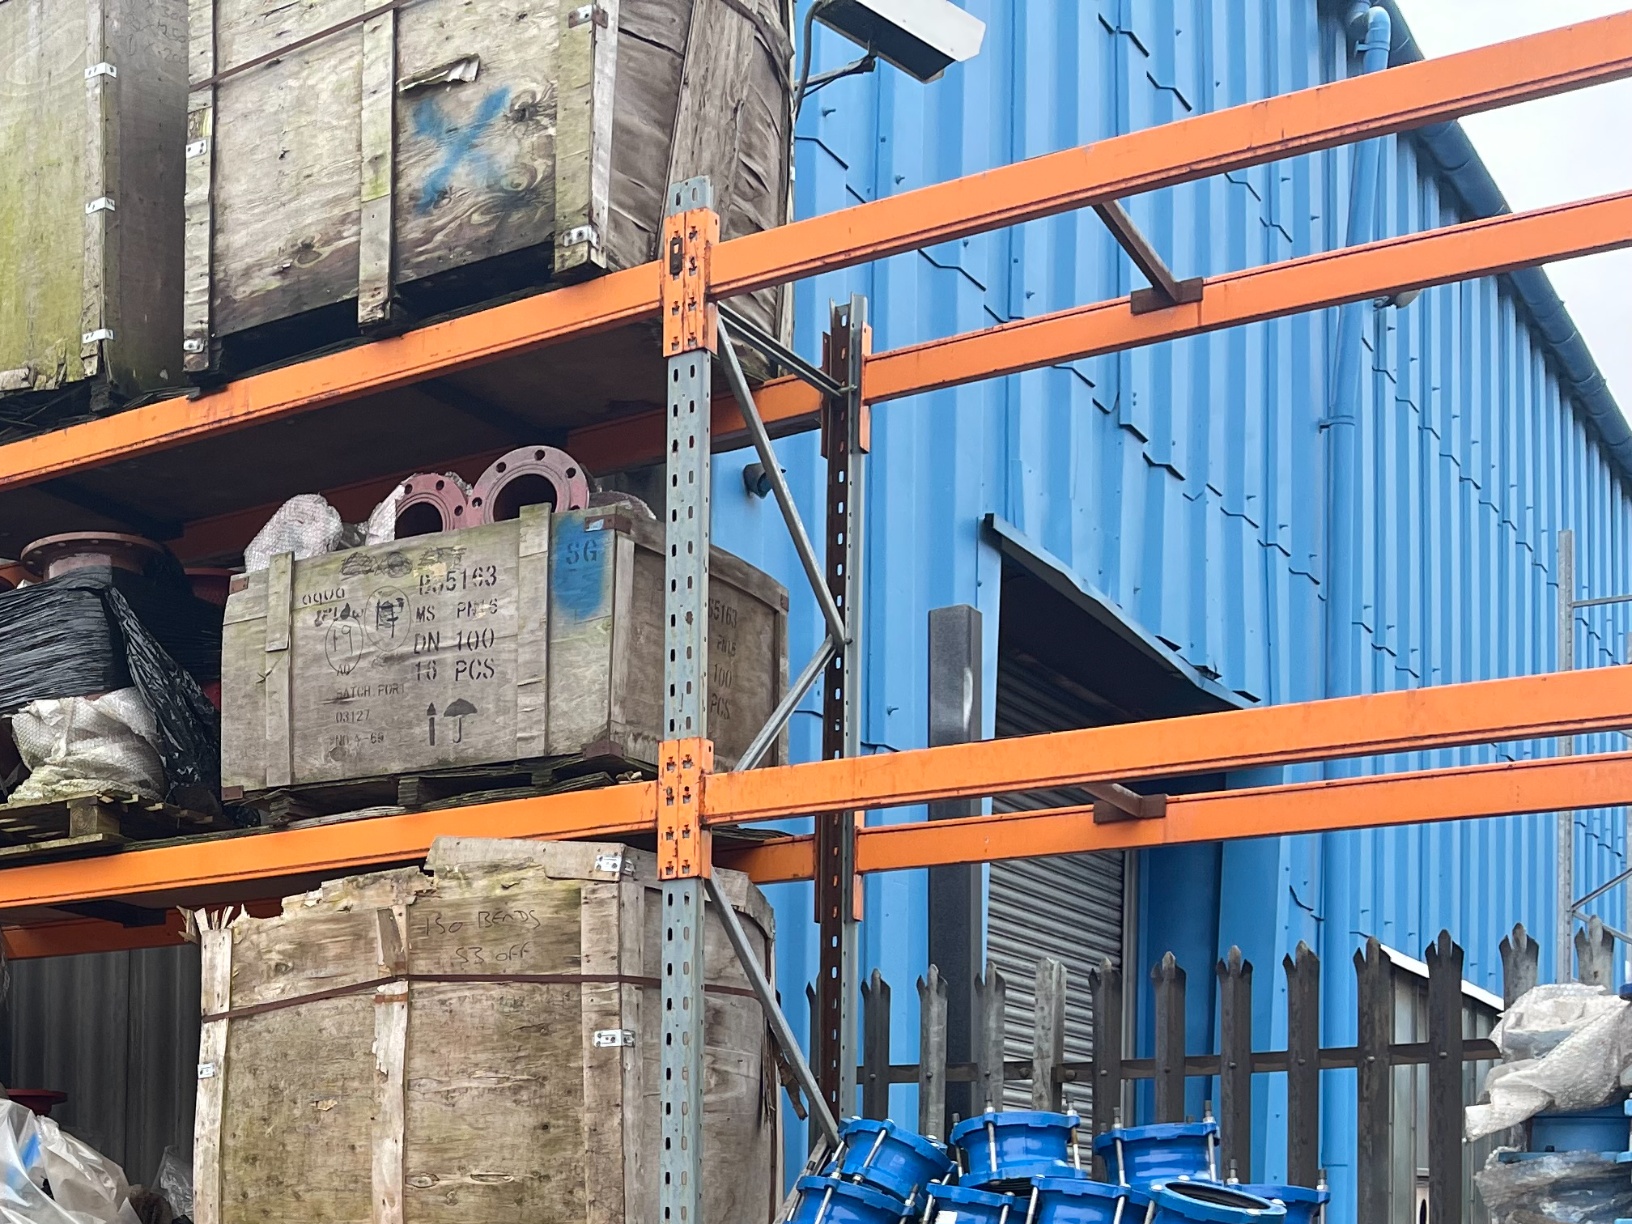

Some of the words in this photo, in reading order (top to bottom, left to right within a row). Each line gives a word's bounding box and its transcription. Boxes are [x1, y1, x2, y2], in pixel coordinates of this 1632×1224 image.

[415, 604, 436, 623] MS
[413, 630, 441, 655] DN
[456, 627, 495, 652] 100
[454, 658, 495, 682] PCS
